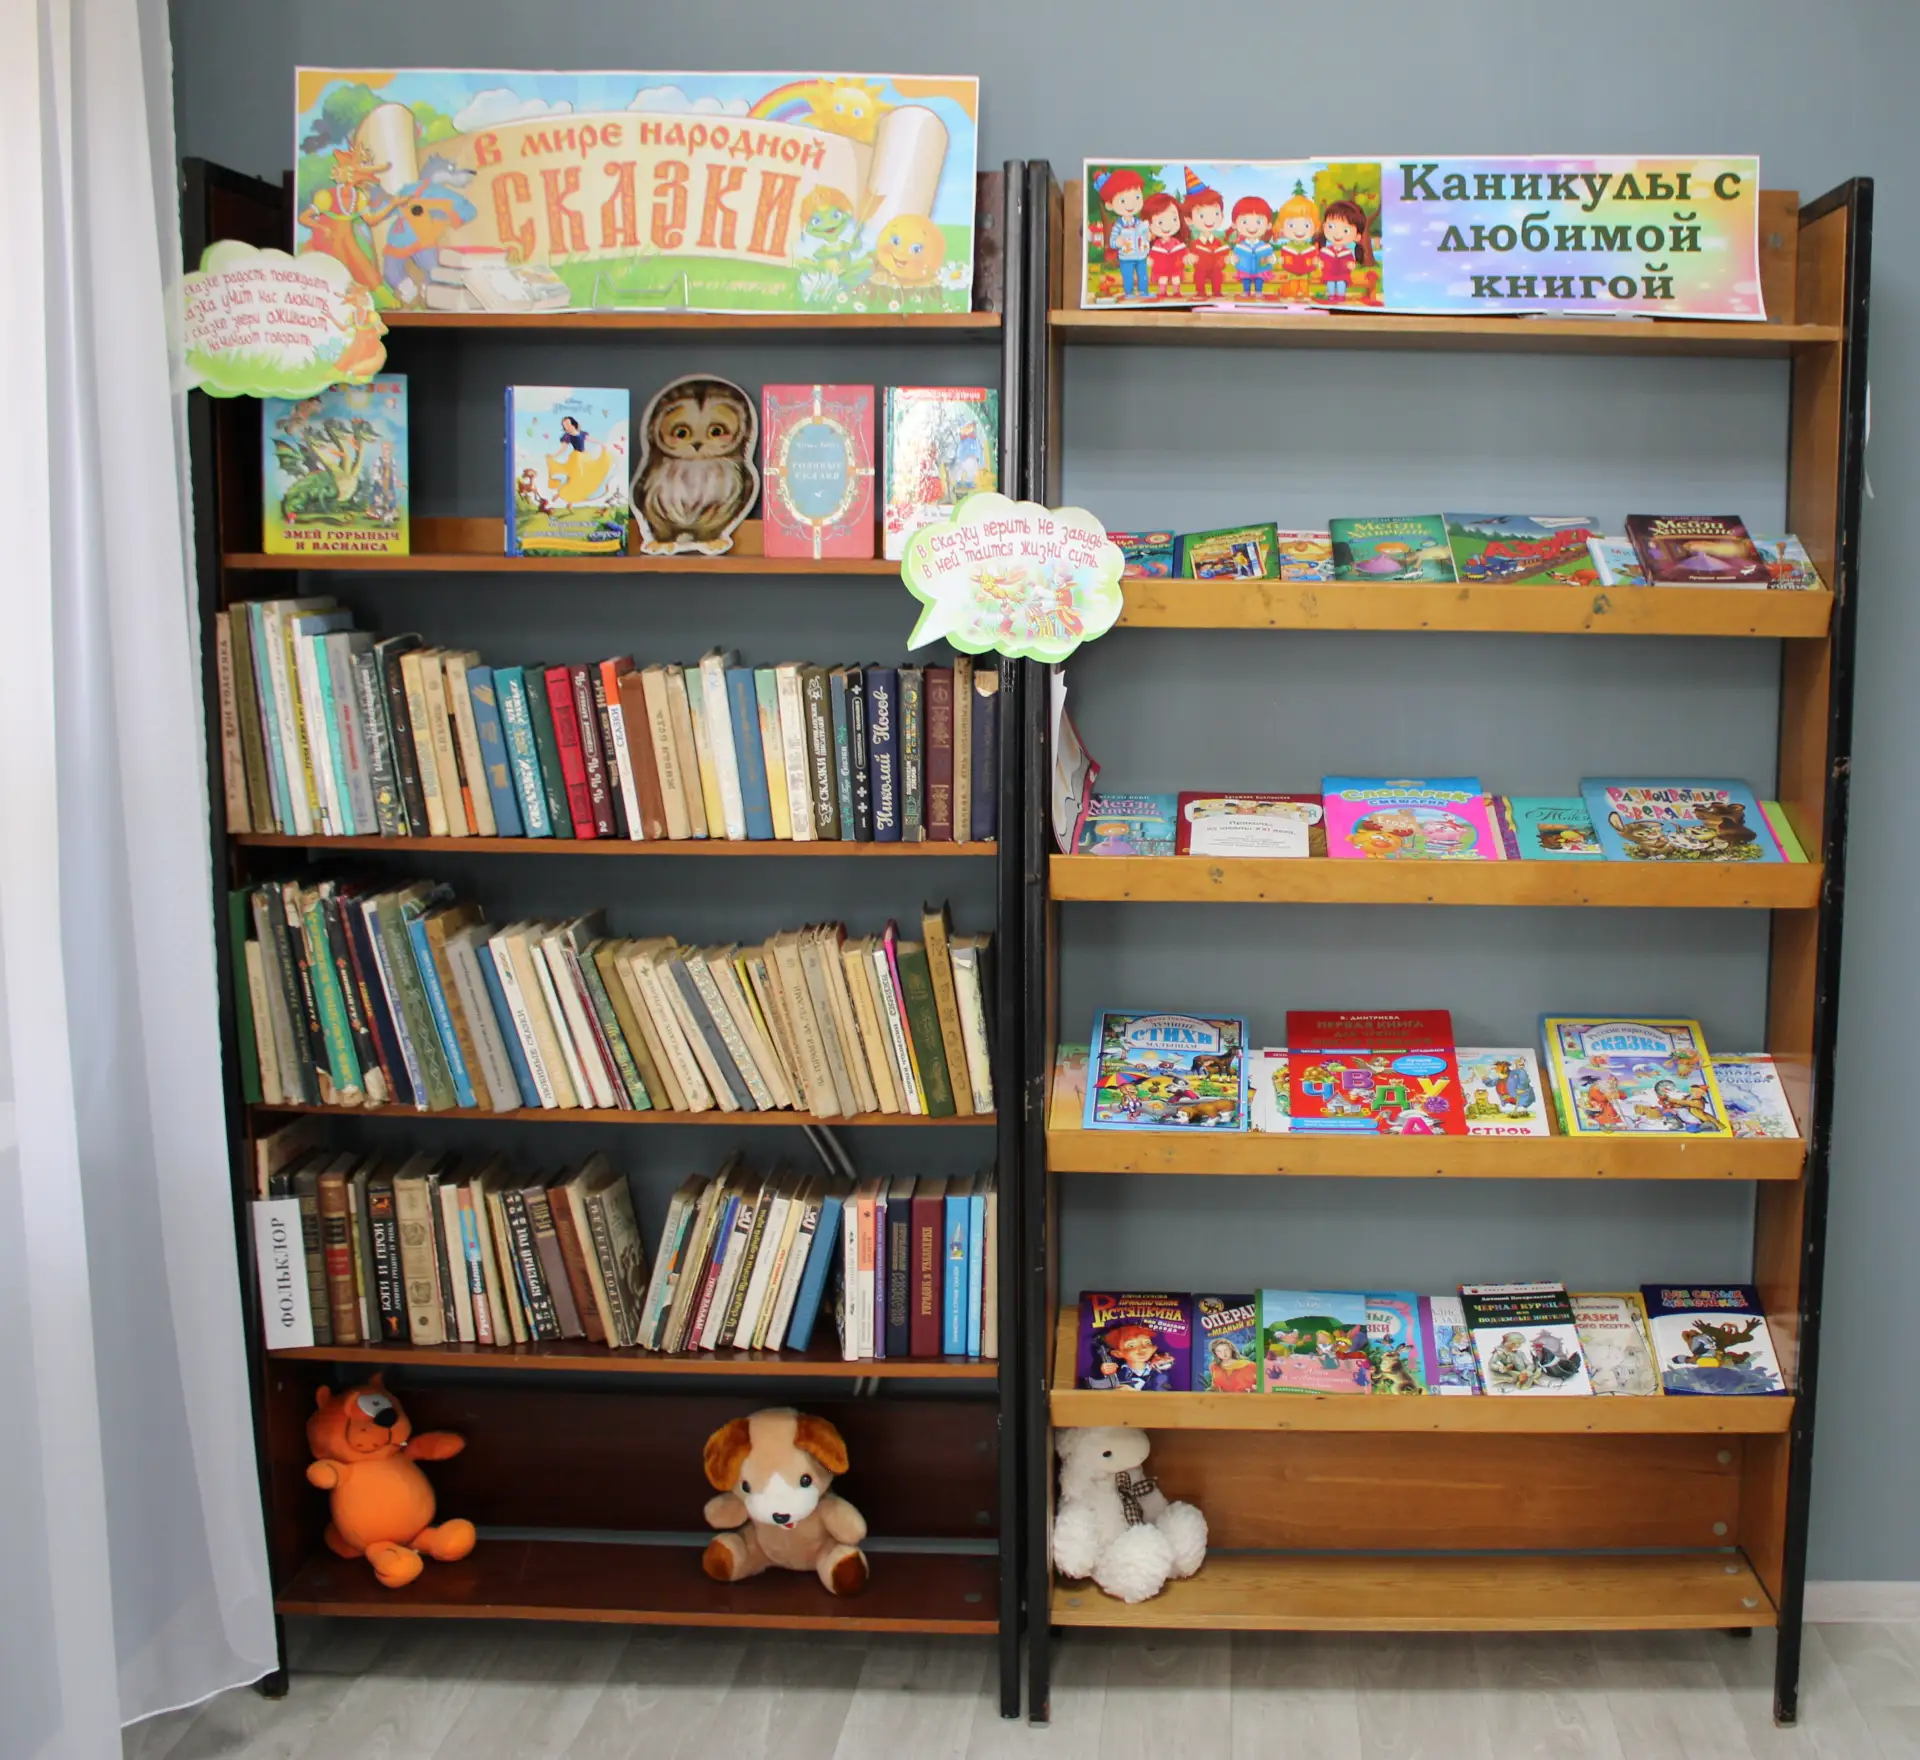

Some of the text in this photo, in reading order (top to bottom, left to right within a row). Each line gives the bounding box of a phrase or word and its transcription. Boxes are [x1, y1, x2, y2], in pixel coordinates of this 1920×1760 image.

[640, 121, 826, 170] народной
[1401, 163, 1741, 212] Каникулы с
[494, 159, 802, 262] СКАЗКИ
[1437, 212, 1703, 254] любимой
[1471, 263, 1675, 300] книгой
[284, 529, 400, 540] ЗМЕЙ ГОРЫНЫЧ
[984, 518, 1031, 541] верить
[1038, 518, 1054, 535] не
[1655, 519, 1724, 529] Мейзи
[312, 542, 388, 551] ВАСИЛИСА
[935, 552, 960, 573] ней
[965, 543, 1014, 562] таится
[1021, 540, 1061, 564] жизни
[612, 708, 624, 748] СКАЗКИ
[811, 702, 820, 755] АМЕРИКАНСКИХ
[818, 716, 827, 756] ПИСАТЕЛЕЙ
[872, 685, 893, 830] Николай Носов
[817, 757, 829, 801] СКАЗКИ
[1090, 799, 1157, 809] Мейзи
[1340, 789, 1473, 804] СЛОВАРИК
[1616, 803, 1694, 820] ЗВЕРЯТА
[1131, 1027, 1213, 1045] СТИХИ
[1317, 1020, 1424, 1029] ПЕРВАЯ КНИГА
[517, 1009, 552, 1099] ЛЮБИМЫЕ СКАЗКИ
[1591, 1035, 1668, 1052] сказки
[1303, 1081, 1335, 1101] Ч
[1342, 1069, 1375, 1090] В
[1371, 1085, 1412, 1111] Д
[516, 1228, 542, 1297] КРУГЛЫЙ ГОД
[589, 1204, 621, 1313] ГЕРОИ ЭЛЛАДЫ
[921, 1227, 933, 1271] ТАБАКЕРКЕ
[270, 1217, 295, 1327] ФОЛЬКЛОР
[373, 1223, 392, 1311] БОГИ И ГЕРОИ
[922, 1281, 933, 1315] ГОРОДОК
[1473, 1303, 1518, 1311] ЧЕРНАЯ
[1478, 1313, 1570, 1323] ПОДЗЕМНЫЕ ЖИТЕЛИ
[1575, 1313, 1619, 1322] КАЗКИ
